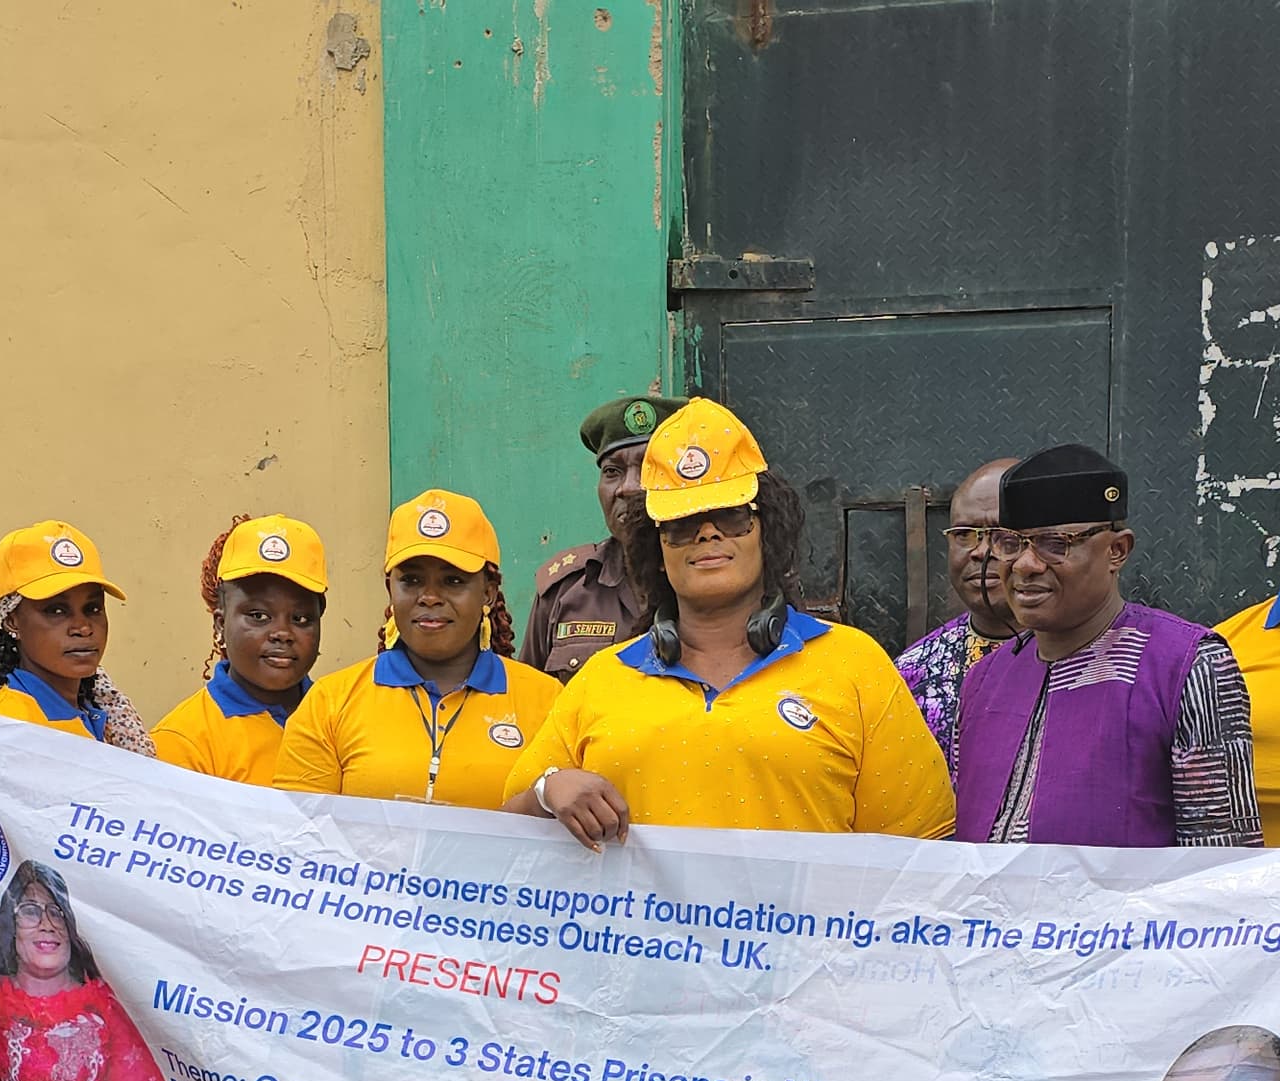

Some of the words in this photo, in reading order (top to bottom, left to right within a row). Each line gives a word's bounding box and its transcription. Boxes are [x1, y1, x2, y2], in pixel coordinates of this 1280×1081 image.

[574, 624, 615, 634] SENFUYE
[54, 834, 121, 869] Star
[125, 850, 244, 897] Prisons
[252, 884, 314, 911] and
[319, 891, 549, 948] Homelessness
[558, 922, 704, 964] Outreach
[720, 939, 771, 971] UK.
[70, 802, 125, 836] The
[132, 819, 292, 875] Homeless
[300, 860, 361, 887] and
[364, 868, 509, 906] prisoners
[516, 886, 634, 919] support
[644, 893, 816, 937] foundation
[825, 911, 881, 948] nig.
[891, 916, 952, 947] aka
[961, 919, 1021, 948] The
[1032, 921, 1135, 957] Bright
[357, 944, 561, 1006] PRESENTS
[153, 979, 289, 1035] Mission
[297, 1010, 393, 1053] 2025
[400, 1028, 436, 1061] to
[445, 1037, 469, 1066] 3
